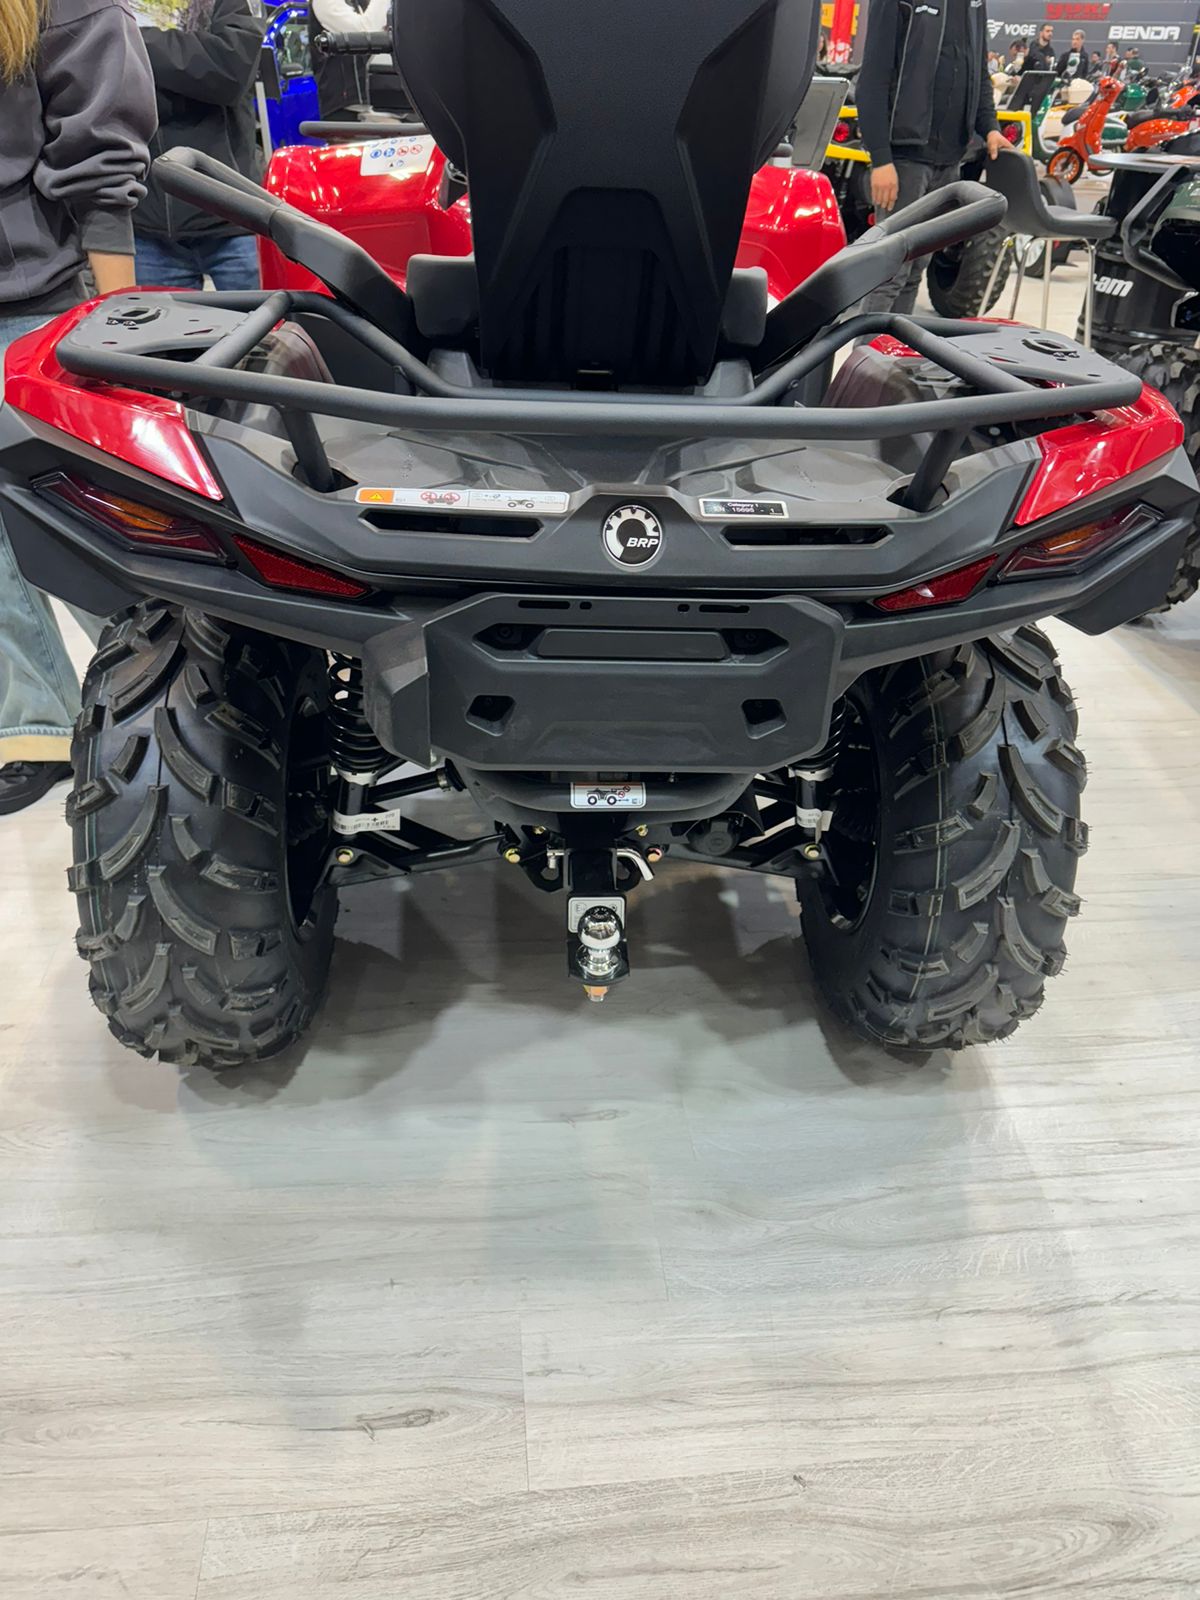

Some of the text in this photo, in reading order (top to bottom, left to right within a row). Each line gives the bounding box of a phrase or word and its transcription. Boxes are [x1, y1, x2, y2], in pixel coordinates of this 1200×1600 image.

[1005, 24, 1037, 36] VOGE
[1108, 26, 1181, 40] BENDA
[626, 537, 659, 548] BRP
